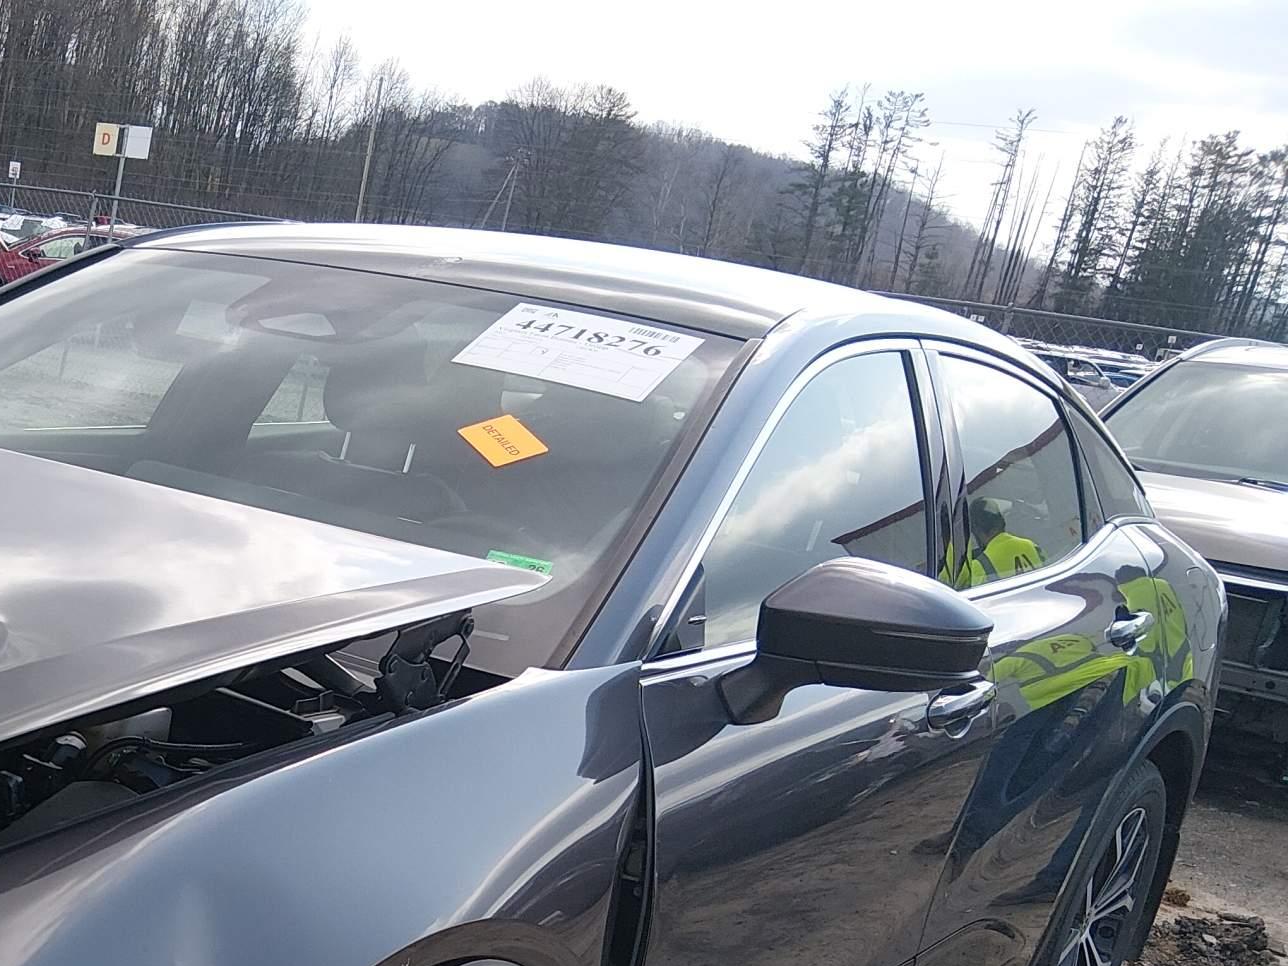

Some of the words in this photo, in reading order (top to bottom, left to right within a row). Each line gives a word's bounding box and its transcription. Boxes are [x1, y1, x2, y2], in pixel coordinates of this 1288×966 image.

[102, 133, 110, 145] D
[515, 319, 663, 357] 44718276
[482, 424, 520, 457] DETAILED
